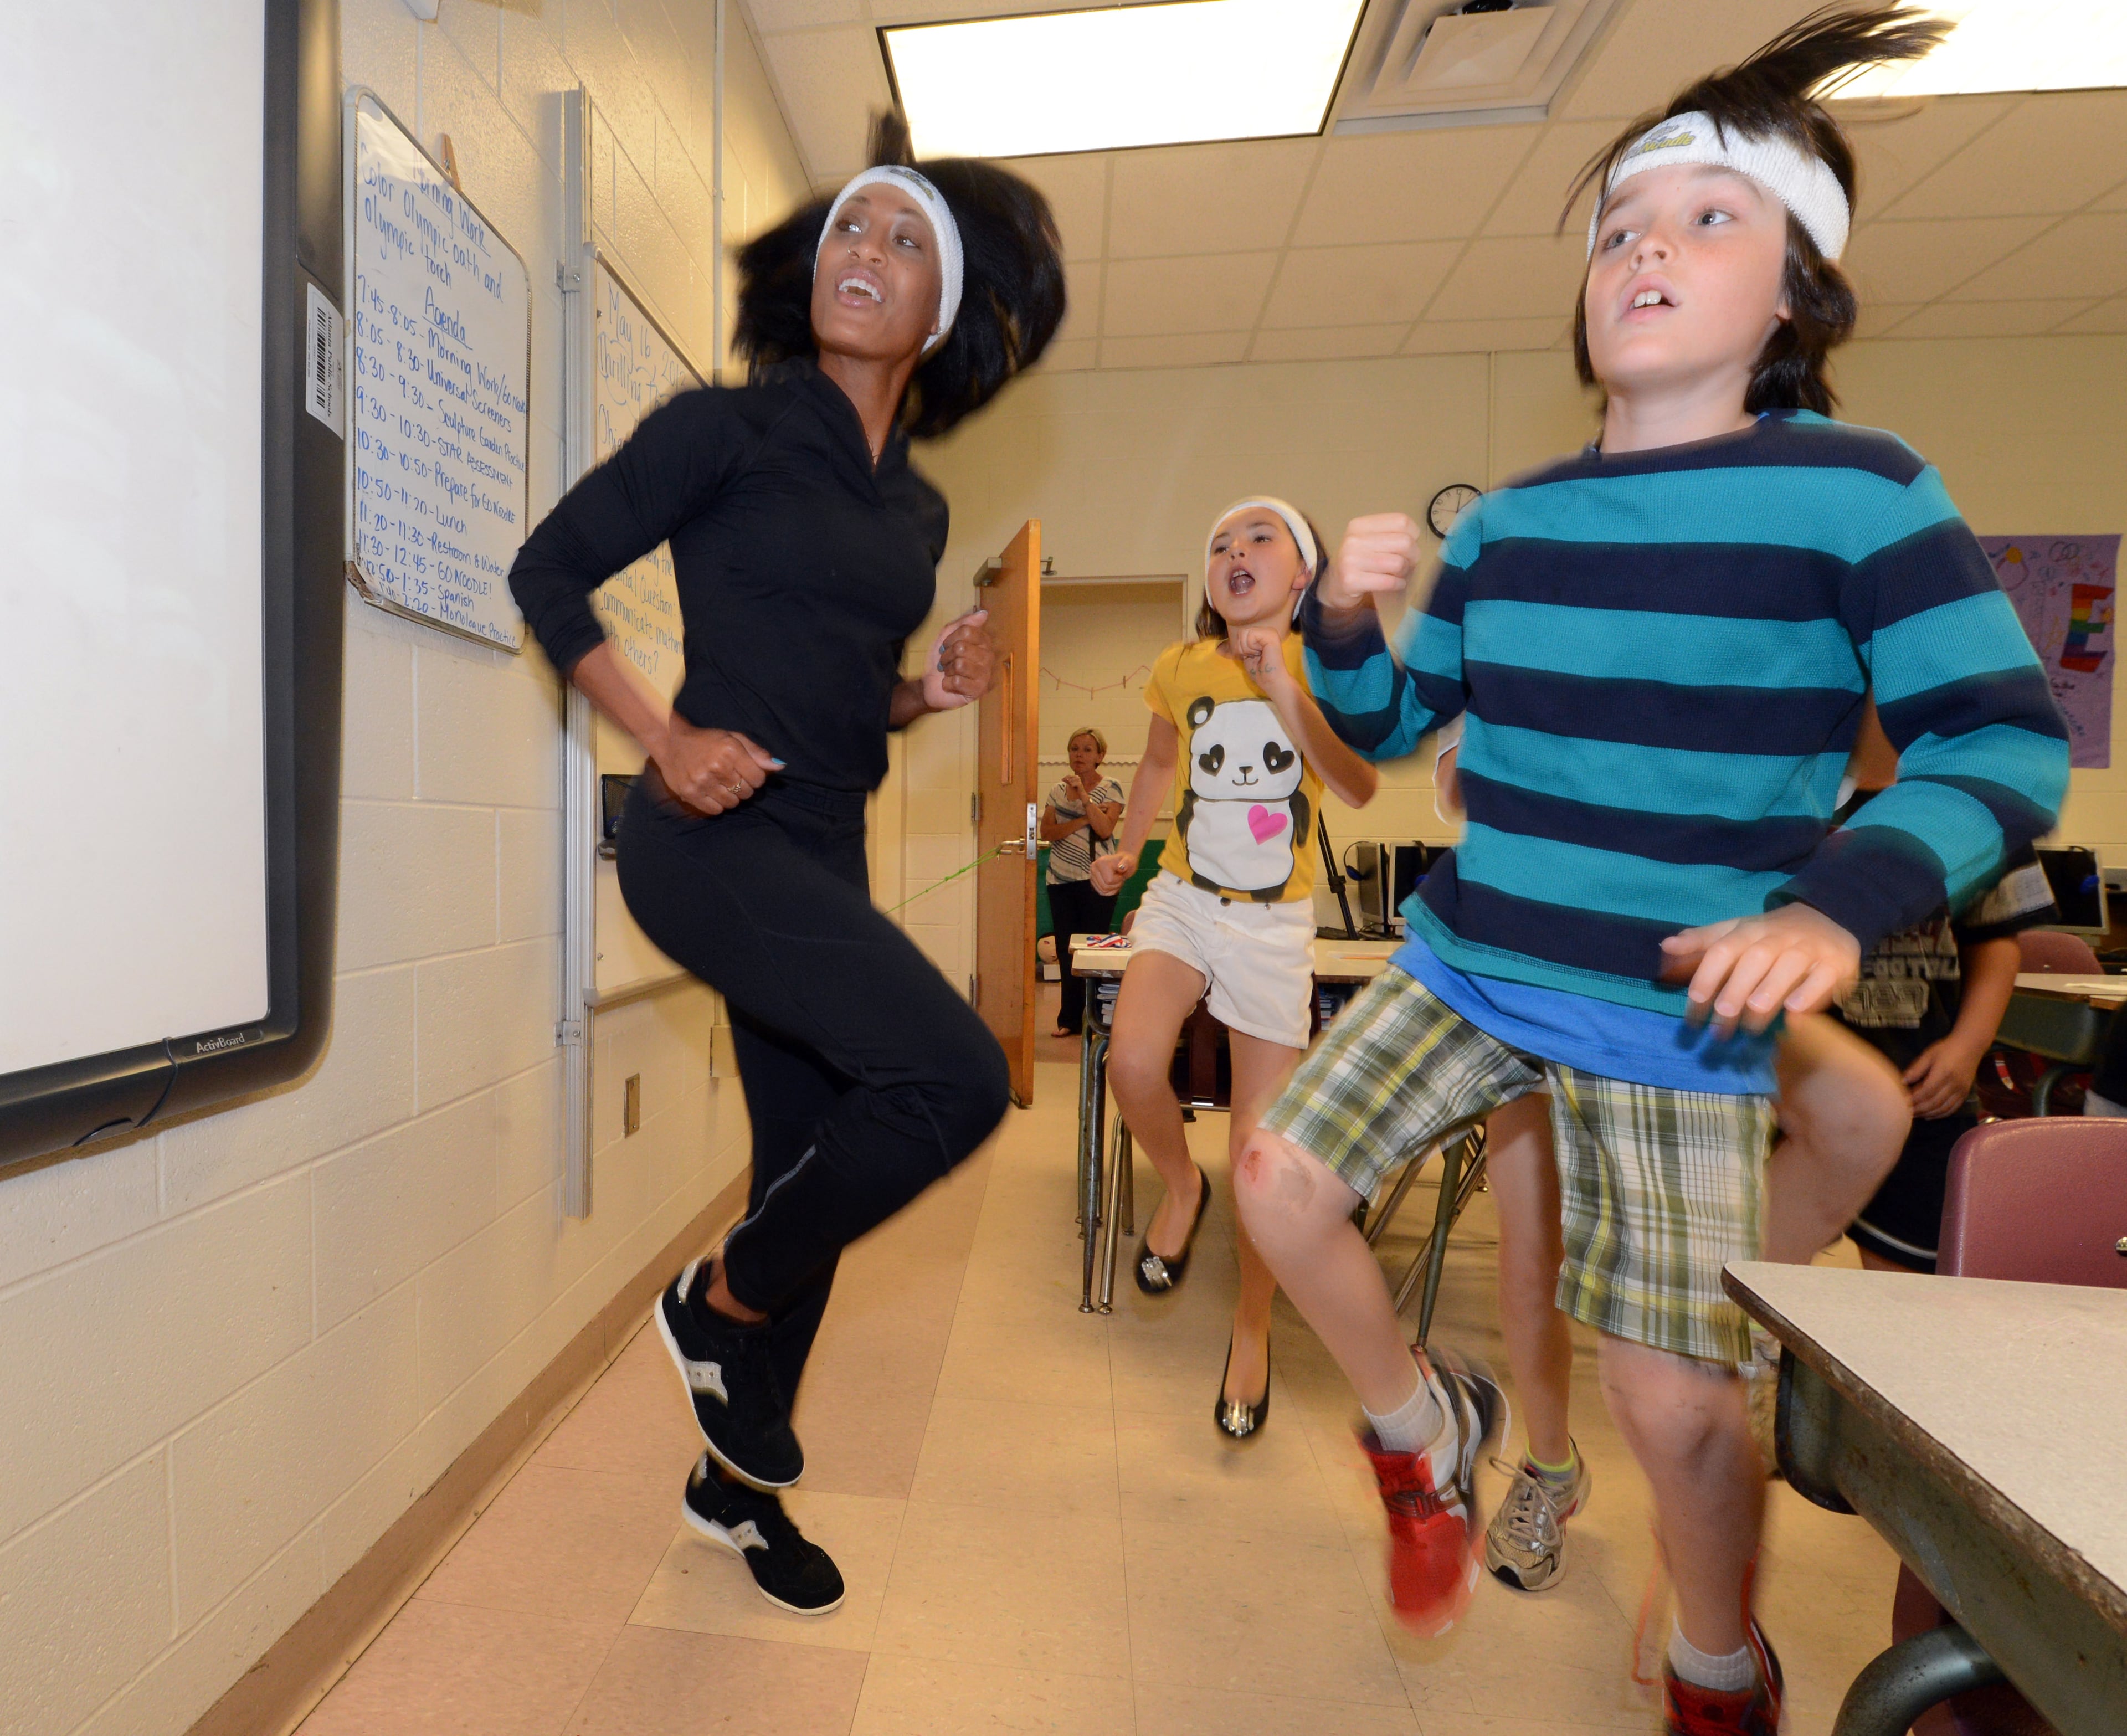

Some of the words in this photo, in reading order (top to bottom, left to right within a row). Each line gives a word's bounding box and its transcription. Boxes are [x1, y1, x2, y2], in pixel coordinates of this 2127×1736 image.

[361, 141, 395, 202] Color
[404, 189, 448, 258] Olympic
[484, 272, 503, 303] and
[366, 195, 414, 260] Olympic
[459, 201, 486, 250] Work
[358, 275, 384, 314] 7:45
[428, 327, 472, 397] Morning
[425, 285, 467, 348] Agenda
[608, 281, 633, 374] May
[662, 350, 686, 394] 2012
[357, 311, 383, 345] 8:05
[397, 341, 420, 371] 8:30
[428, 359, 468, 404] Universal
[472, 389, 511, 432] Screeners
[357, 346, 385, 381] 8:30
[399, 375, 424, 408] 9:30
[439, 399, 475, 444] Sculpture
[357, 386, 386, 422] 9:30
[400, 415, 430, 447] 10:30
[438, 437, 463, 463] STAR
[358, 427, 389, 460] 10:30
[399, 451, 427, 477] 10:50
[435, 461, 468, 505] Prepare
[470, 483, 480, 509] for
[358, 467, 391, 500] 10:50
[436, 505, 467, 537] Lunch
[360, 500, 387, 531] 11:20
[431, 532, 471, 565] Restroom
[395, 545, 427, 573] 12:45
[402, 592, 428, 613] 2:20
[489, 622, 516, 648] Practice
[403, 572, 428, 594] 1:35
[438, 584, 474, 612] Spanish
[624, 636, 659, 680] others?
[197, 1033, 245, 1054] ActivBoard
